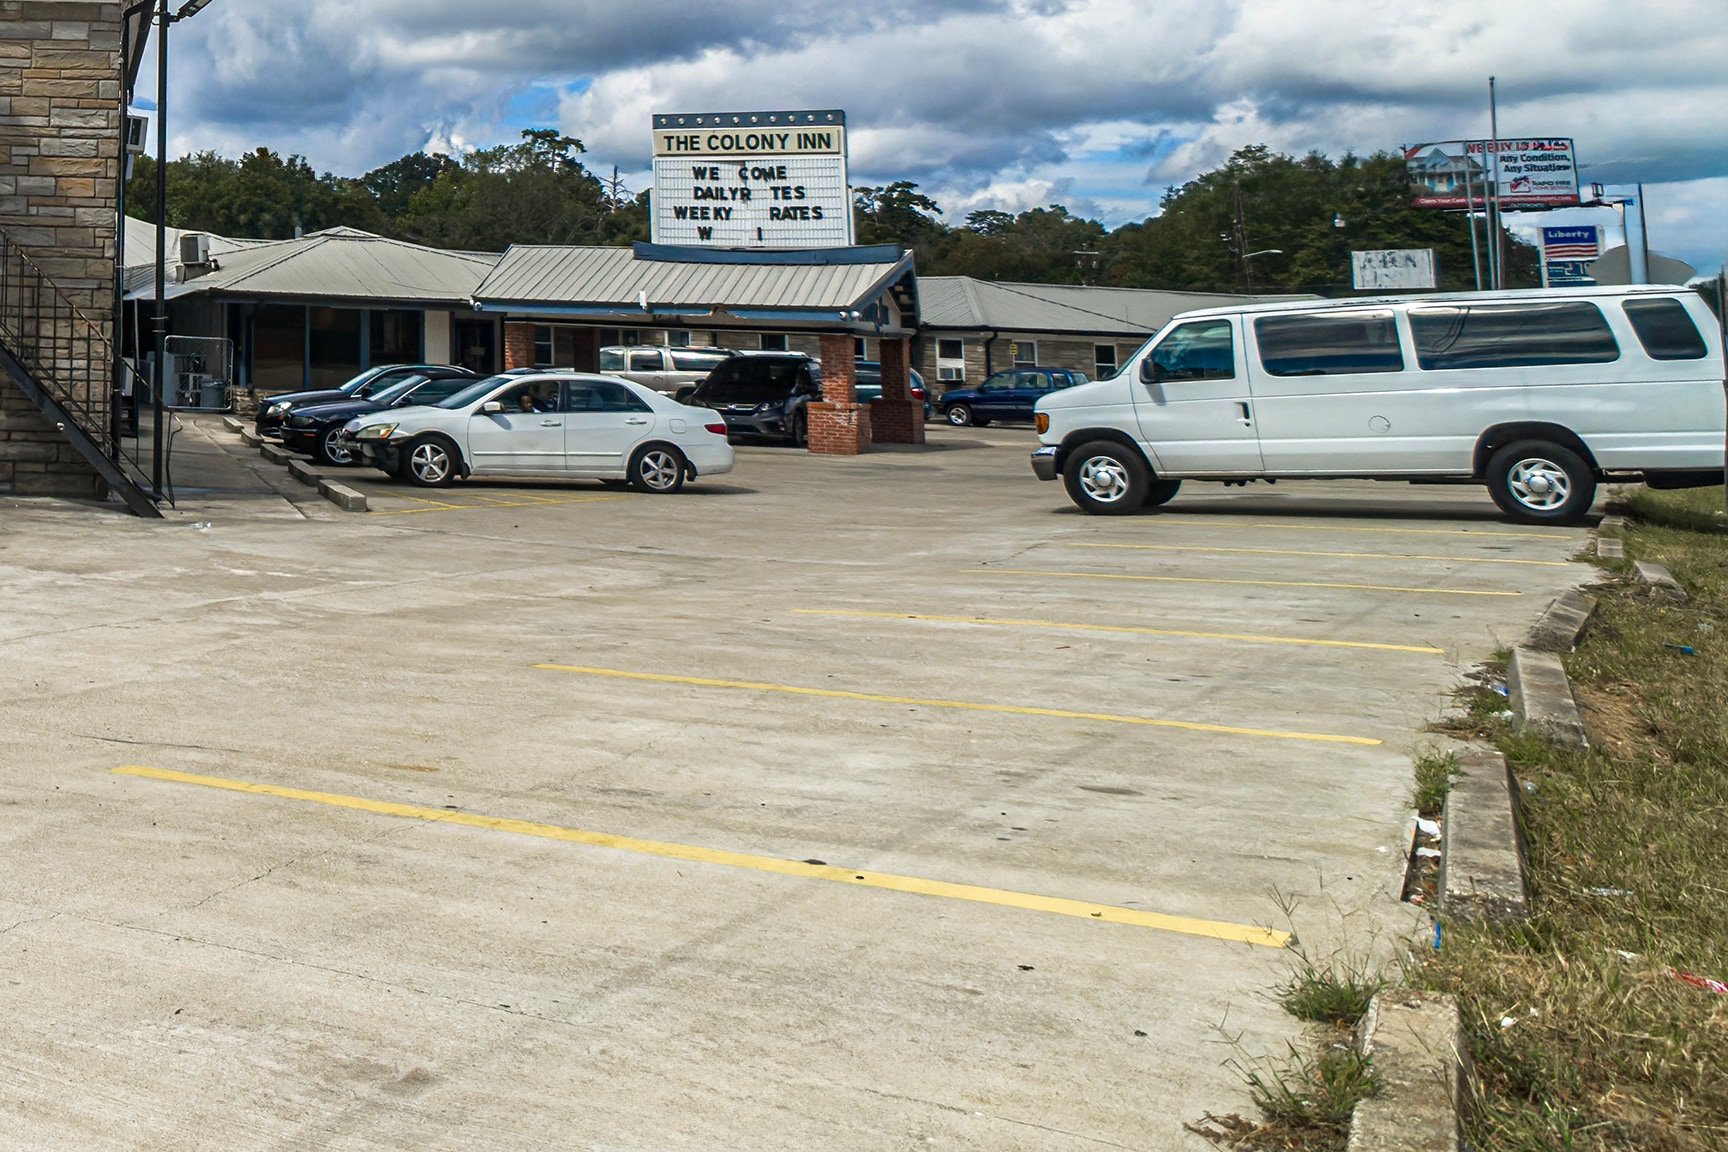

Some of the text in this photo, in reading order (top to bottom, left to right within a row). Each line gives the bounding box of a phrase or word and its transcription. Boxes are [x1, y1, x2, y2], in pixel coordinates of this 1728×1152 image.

[663, 133, 831, 151] THE COLONY INN
[1500, 152, 1571, 163] Any Condition,
[1503, 164, 1522, 174] Any
[770, 206, 823, 220] RATES
[1548, 231, 1590, 239] Liberty
